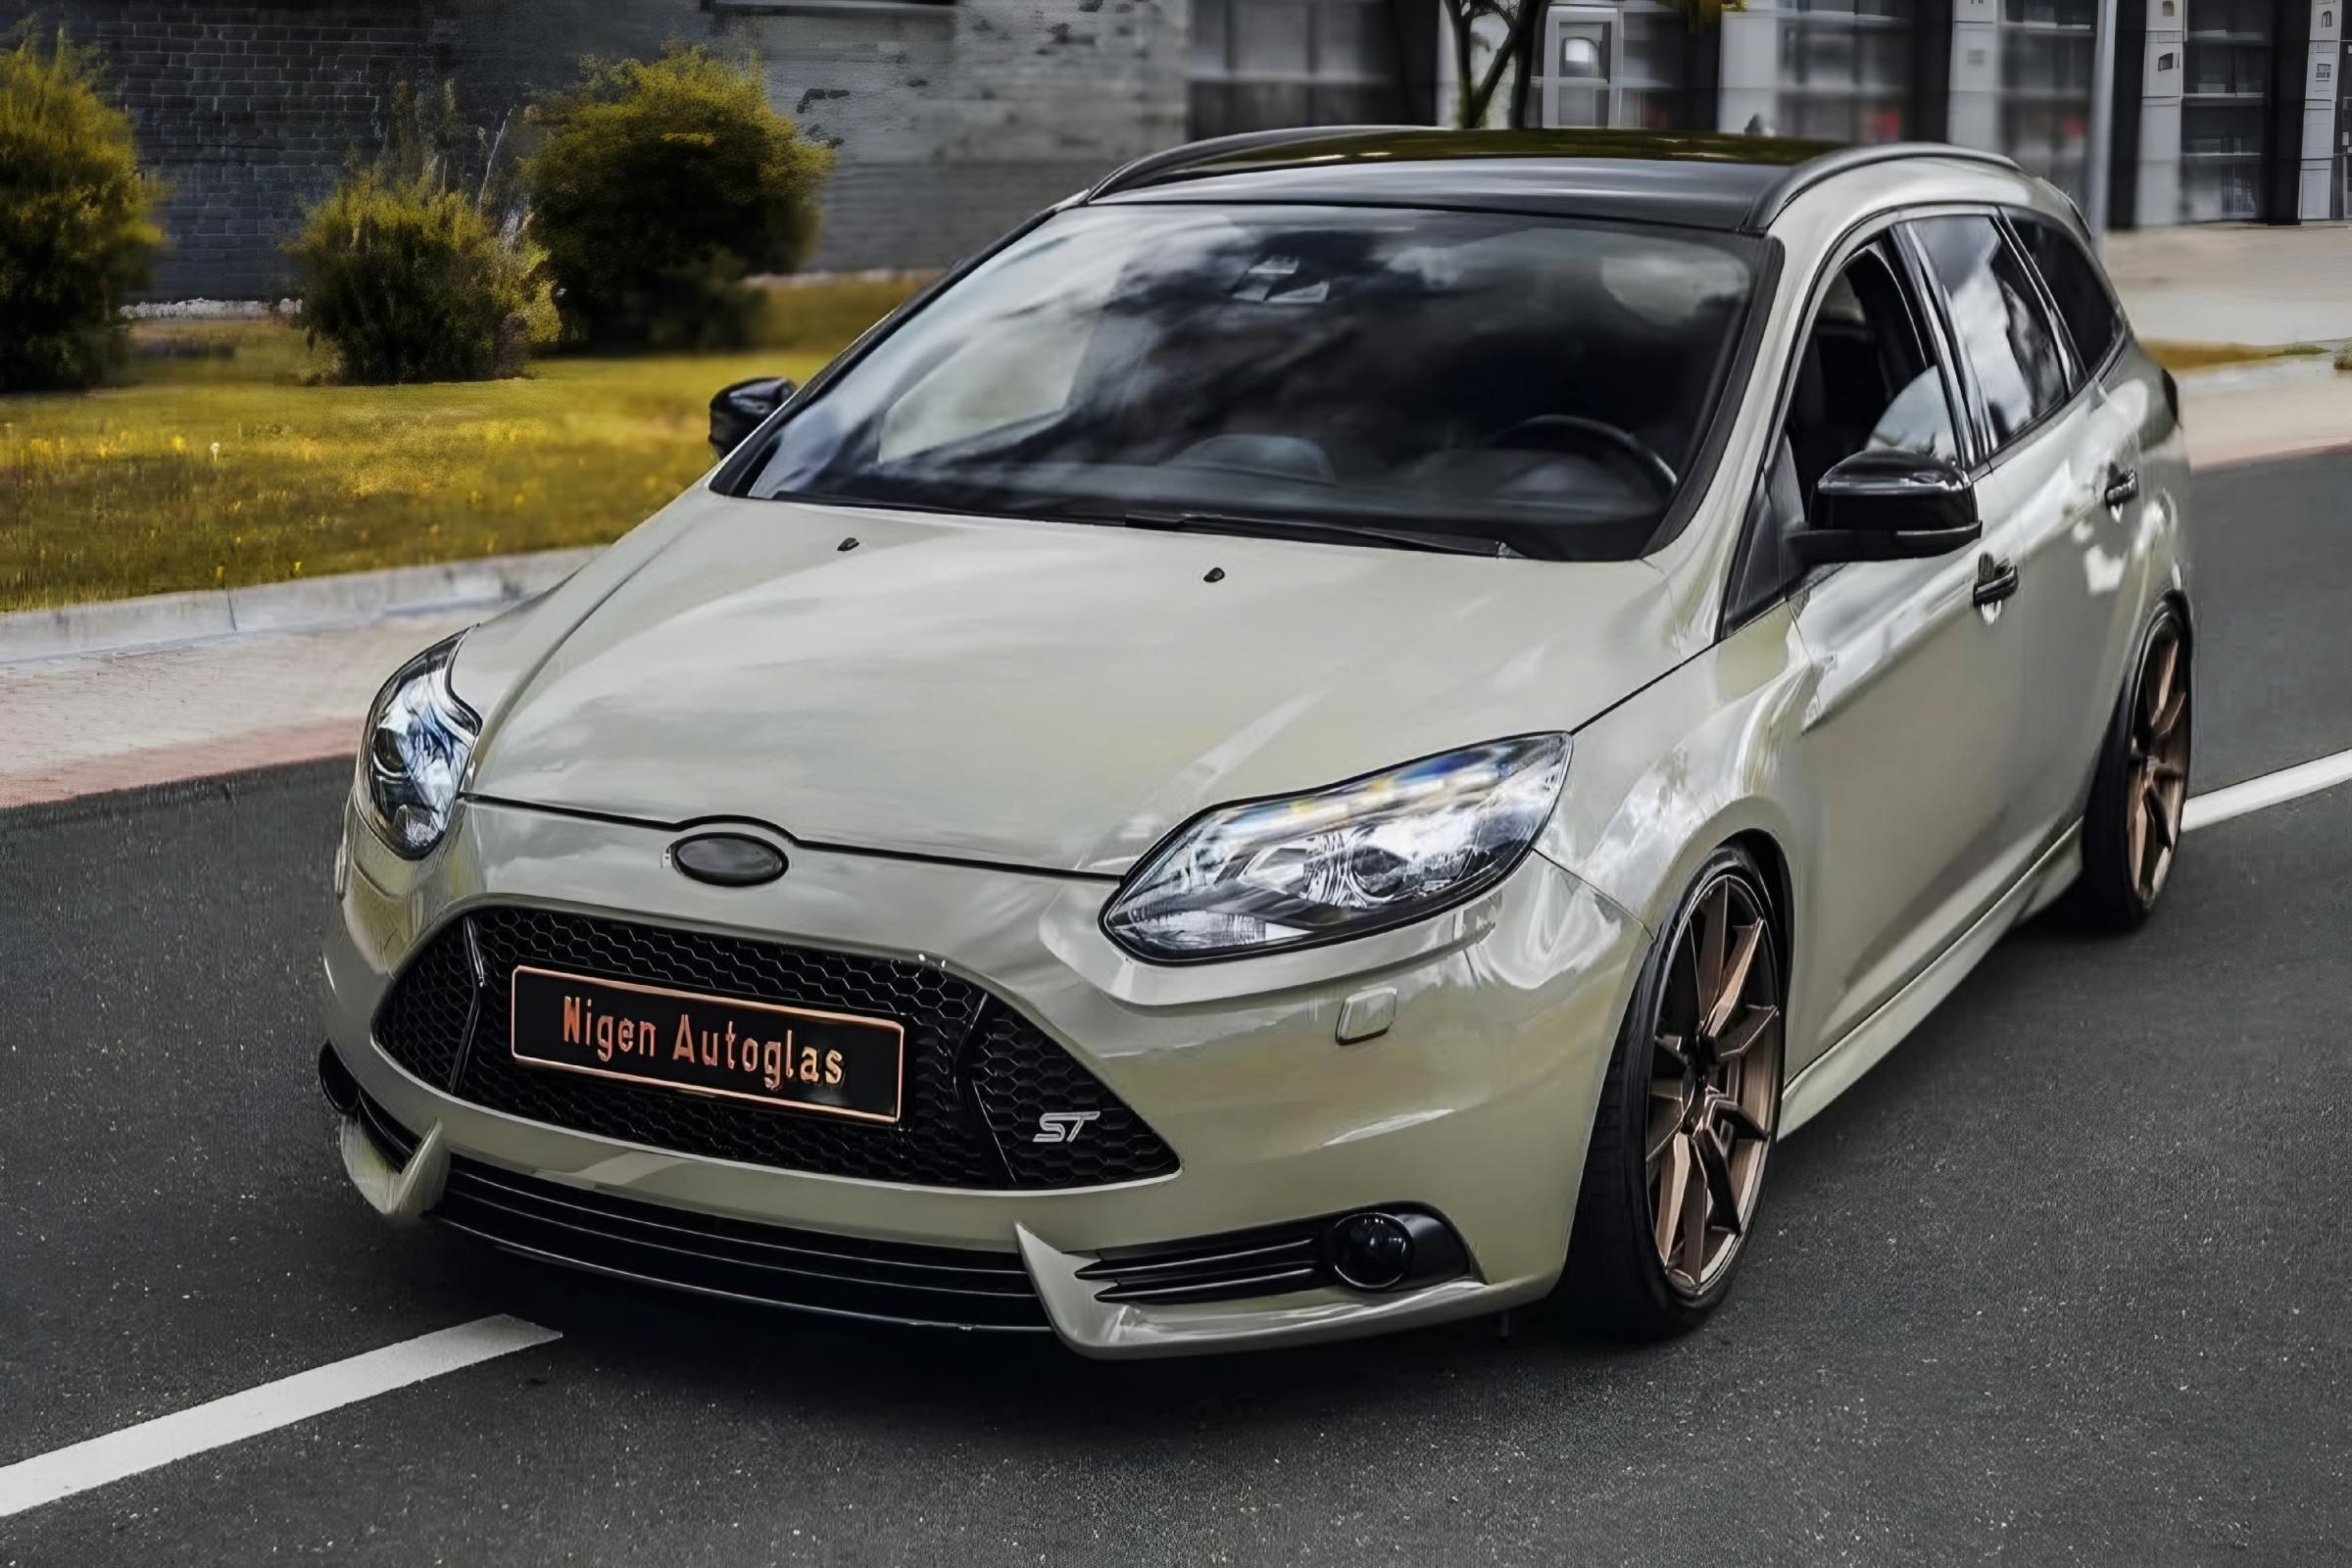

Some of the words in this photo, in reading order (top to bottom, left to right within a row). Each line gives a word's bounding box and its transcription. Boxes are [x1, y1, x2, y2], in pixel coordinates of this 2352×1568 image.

[563, 995, 657, 1062] Nigen
[672, 1013, 846, 1091] Autoglas
[1032, 1110, 1102, 1144] ST
